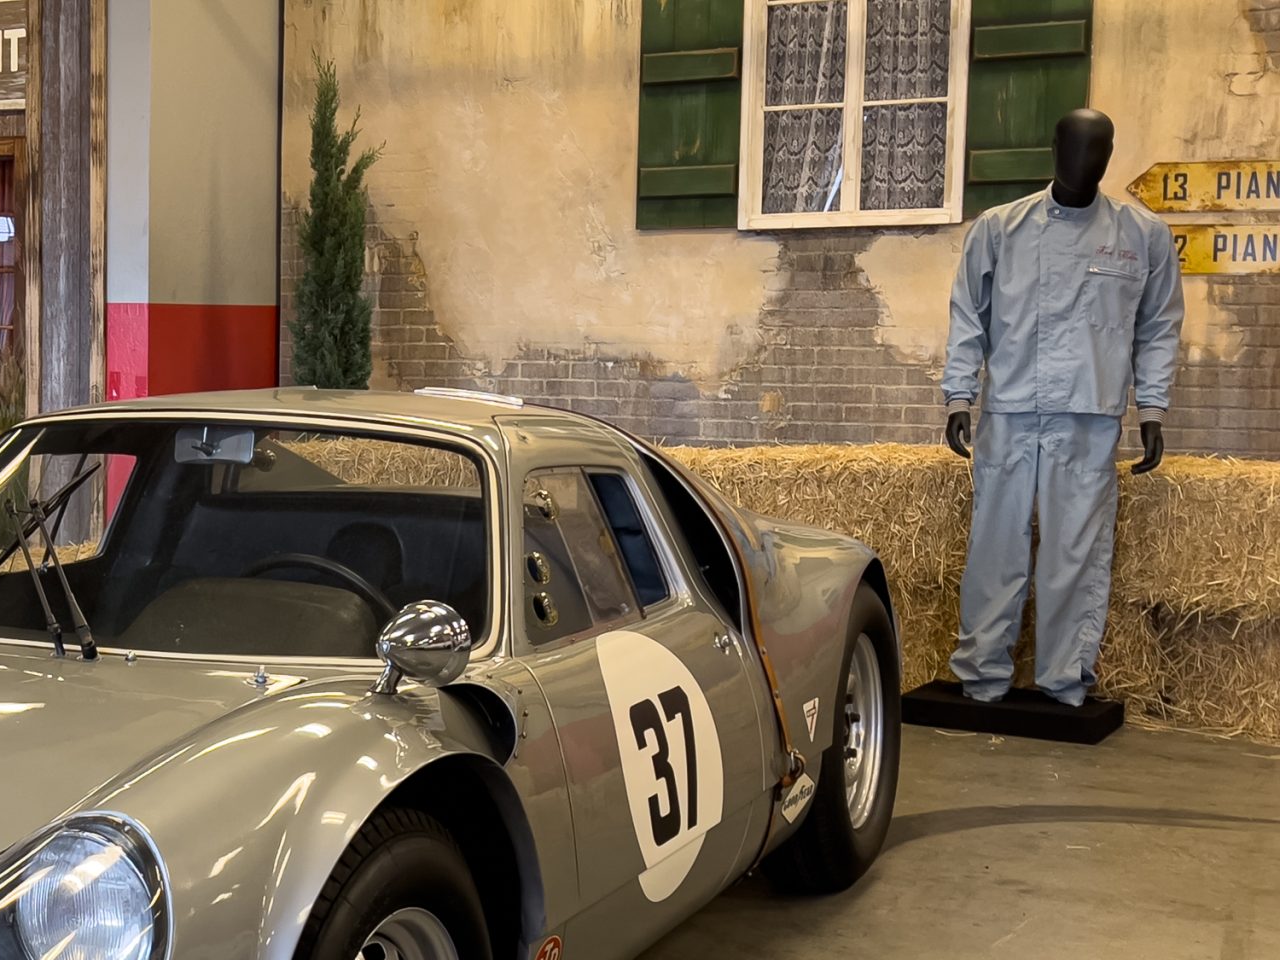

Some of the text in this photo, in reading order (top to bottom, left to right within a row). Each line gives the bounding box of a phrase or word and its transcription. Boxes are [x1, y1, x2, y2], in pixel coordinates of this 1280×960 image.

[1162, 173, 1188, 201] 13
[1213, 233, 1277, 262] PIAN
[629, 685, 698, 846] 37
